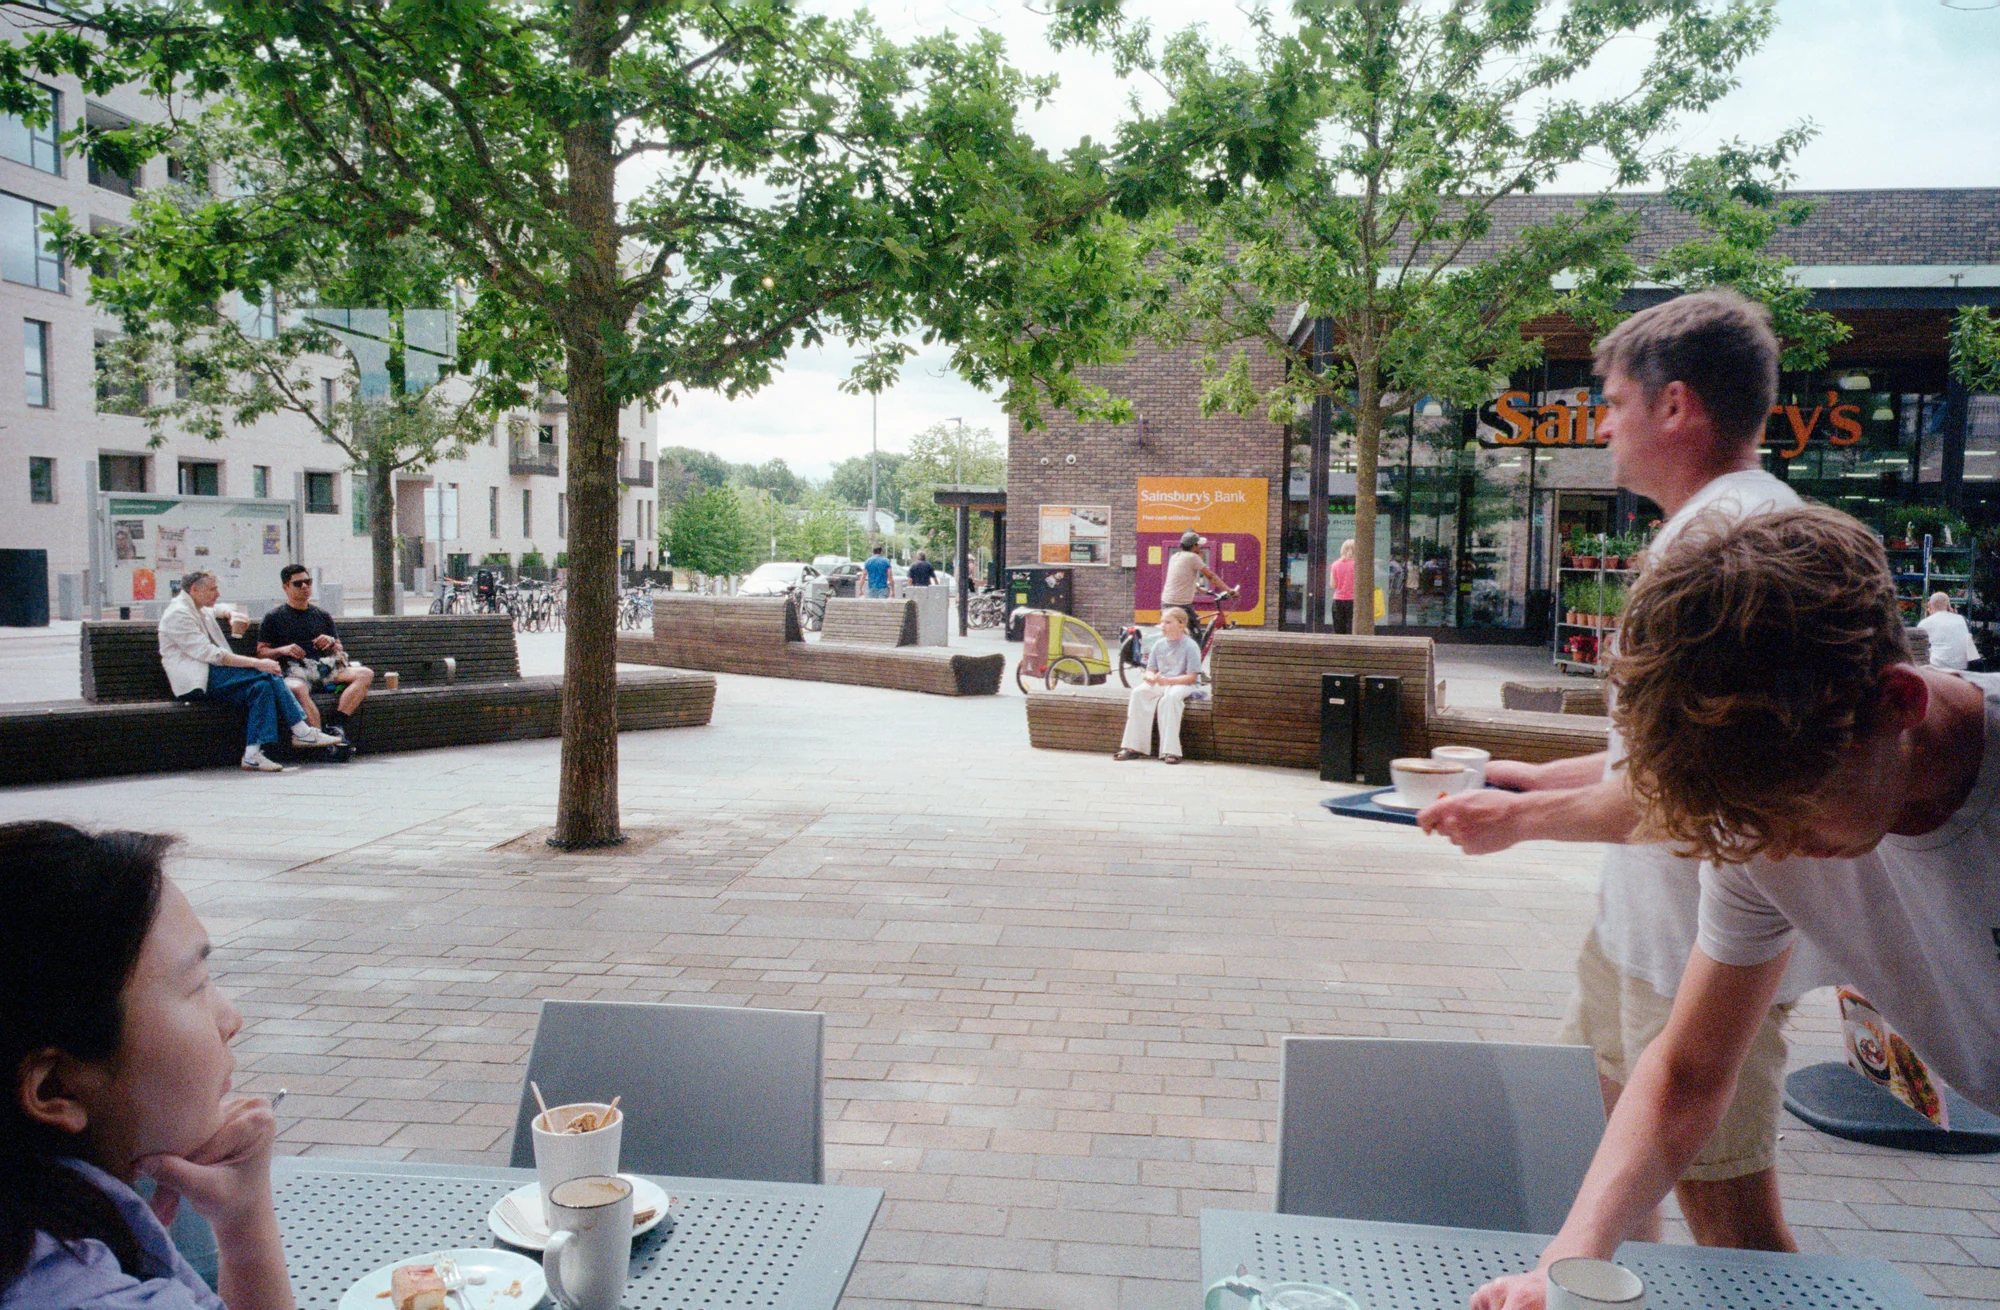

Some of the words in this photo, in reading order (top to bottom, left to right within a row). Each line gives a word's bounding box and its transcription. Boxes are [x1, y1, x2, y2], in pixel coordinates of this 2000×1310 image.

[1495, 391, 1863, 459] Sairy's
[1141, 490, 1210, 504] Sainsbury's
[1215, 491, 1246, 503] Bank
